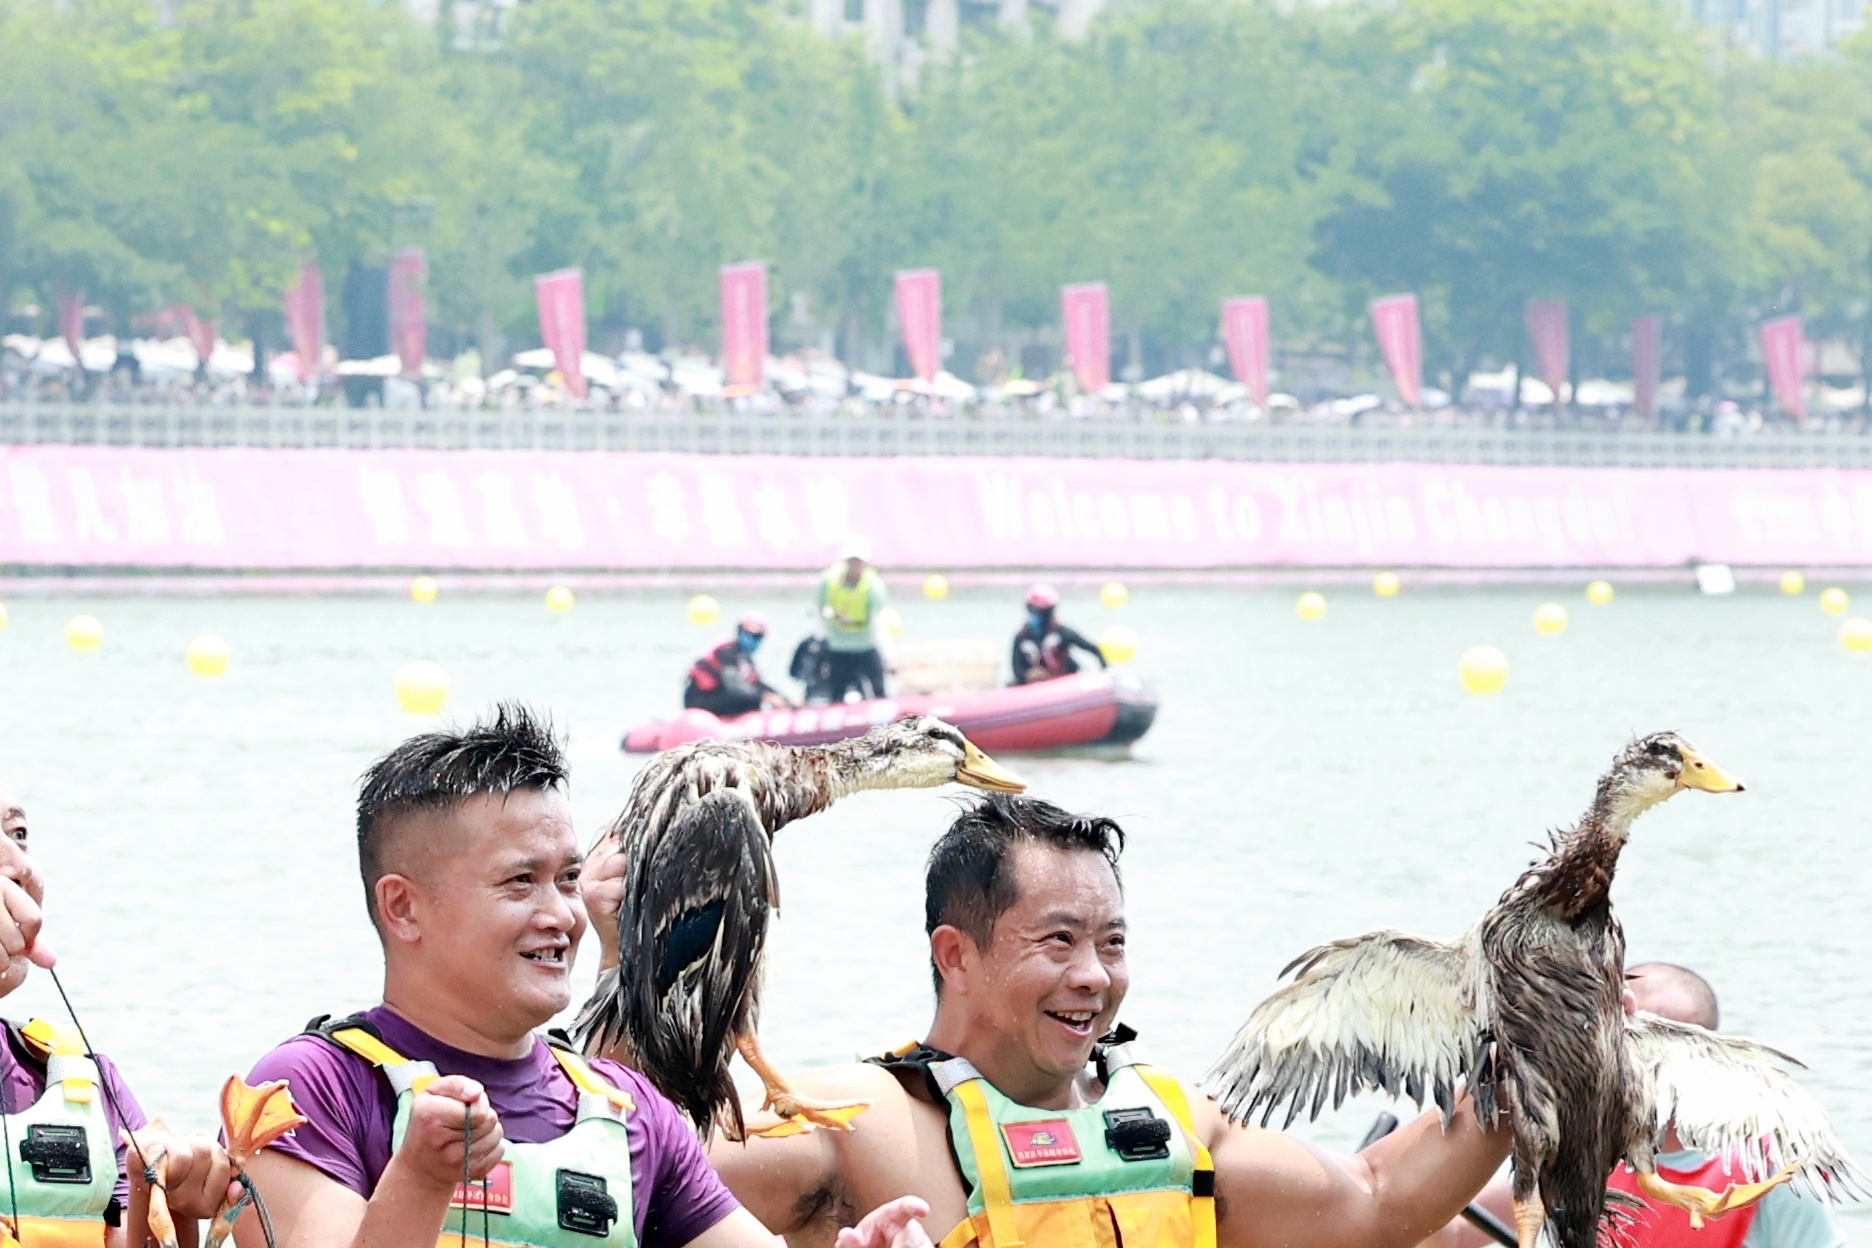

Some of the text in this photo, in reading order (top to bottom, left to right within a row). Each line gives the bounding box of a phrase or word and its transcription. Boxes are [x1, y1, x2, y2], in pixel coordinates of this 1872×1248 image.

[977, 469, 1199, 541] Welcome
[1209, 484, 1261, 541] to
[1272, 475, 1416, 556] Xinjin
